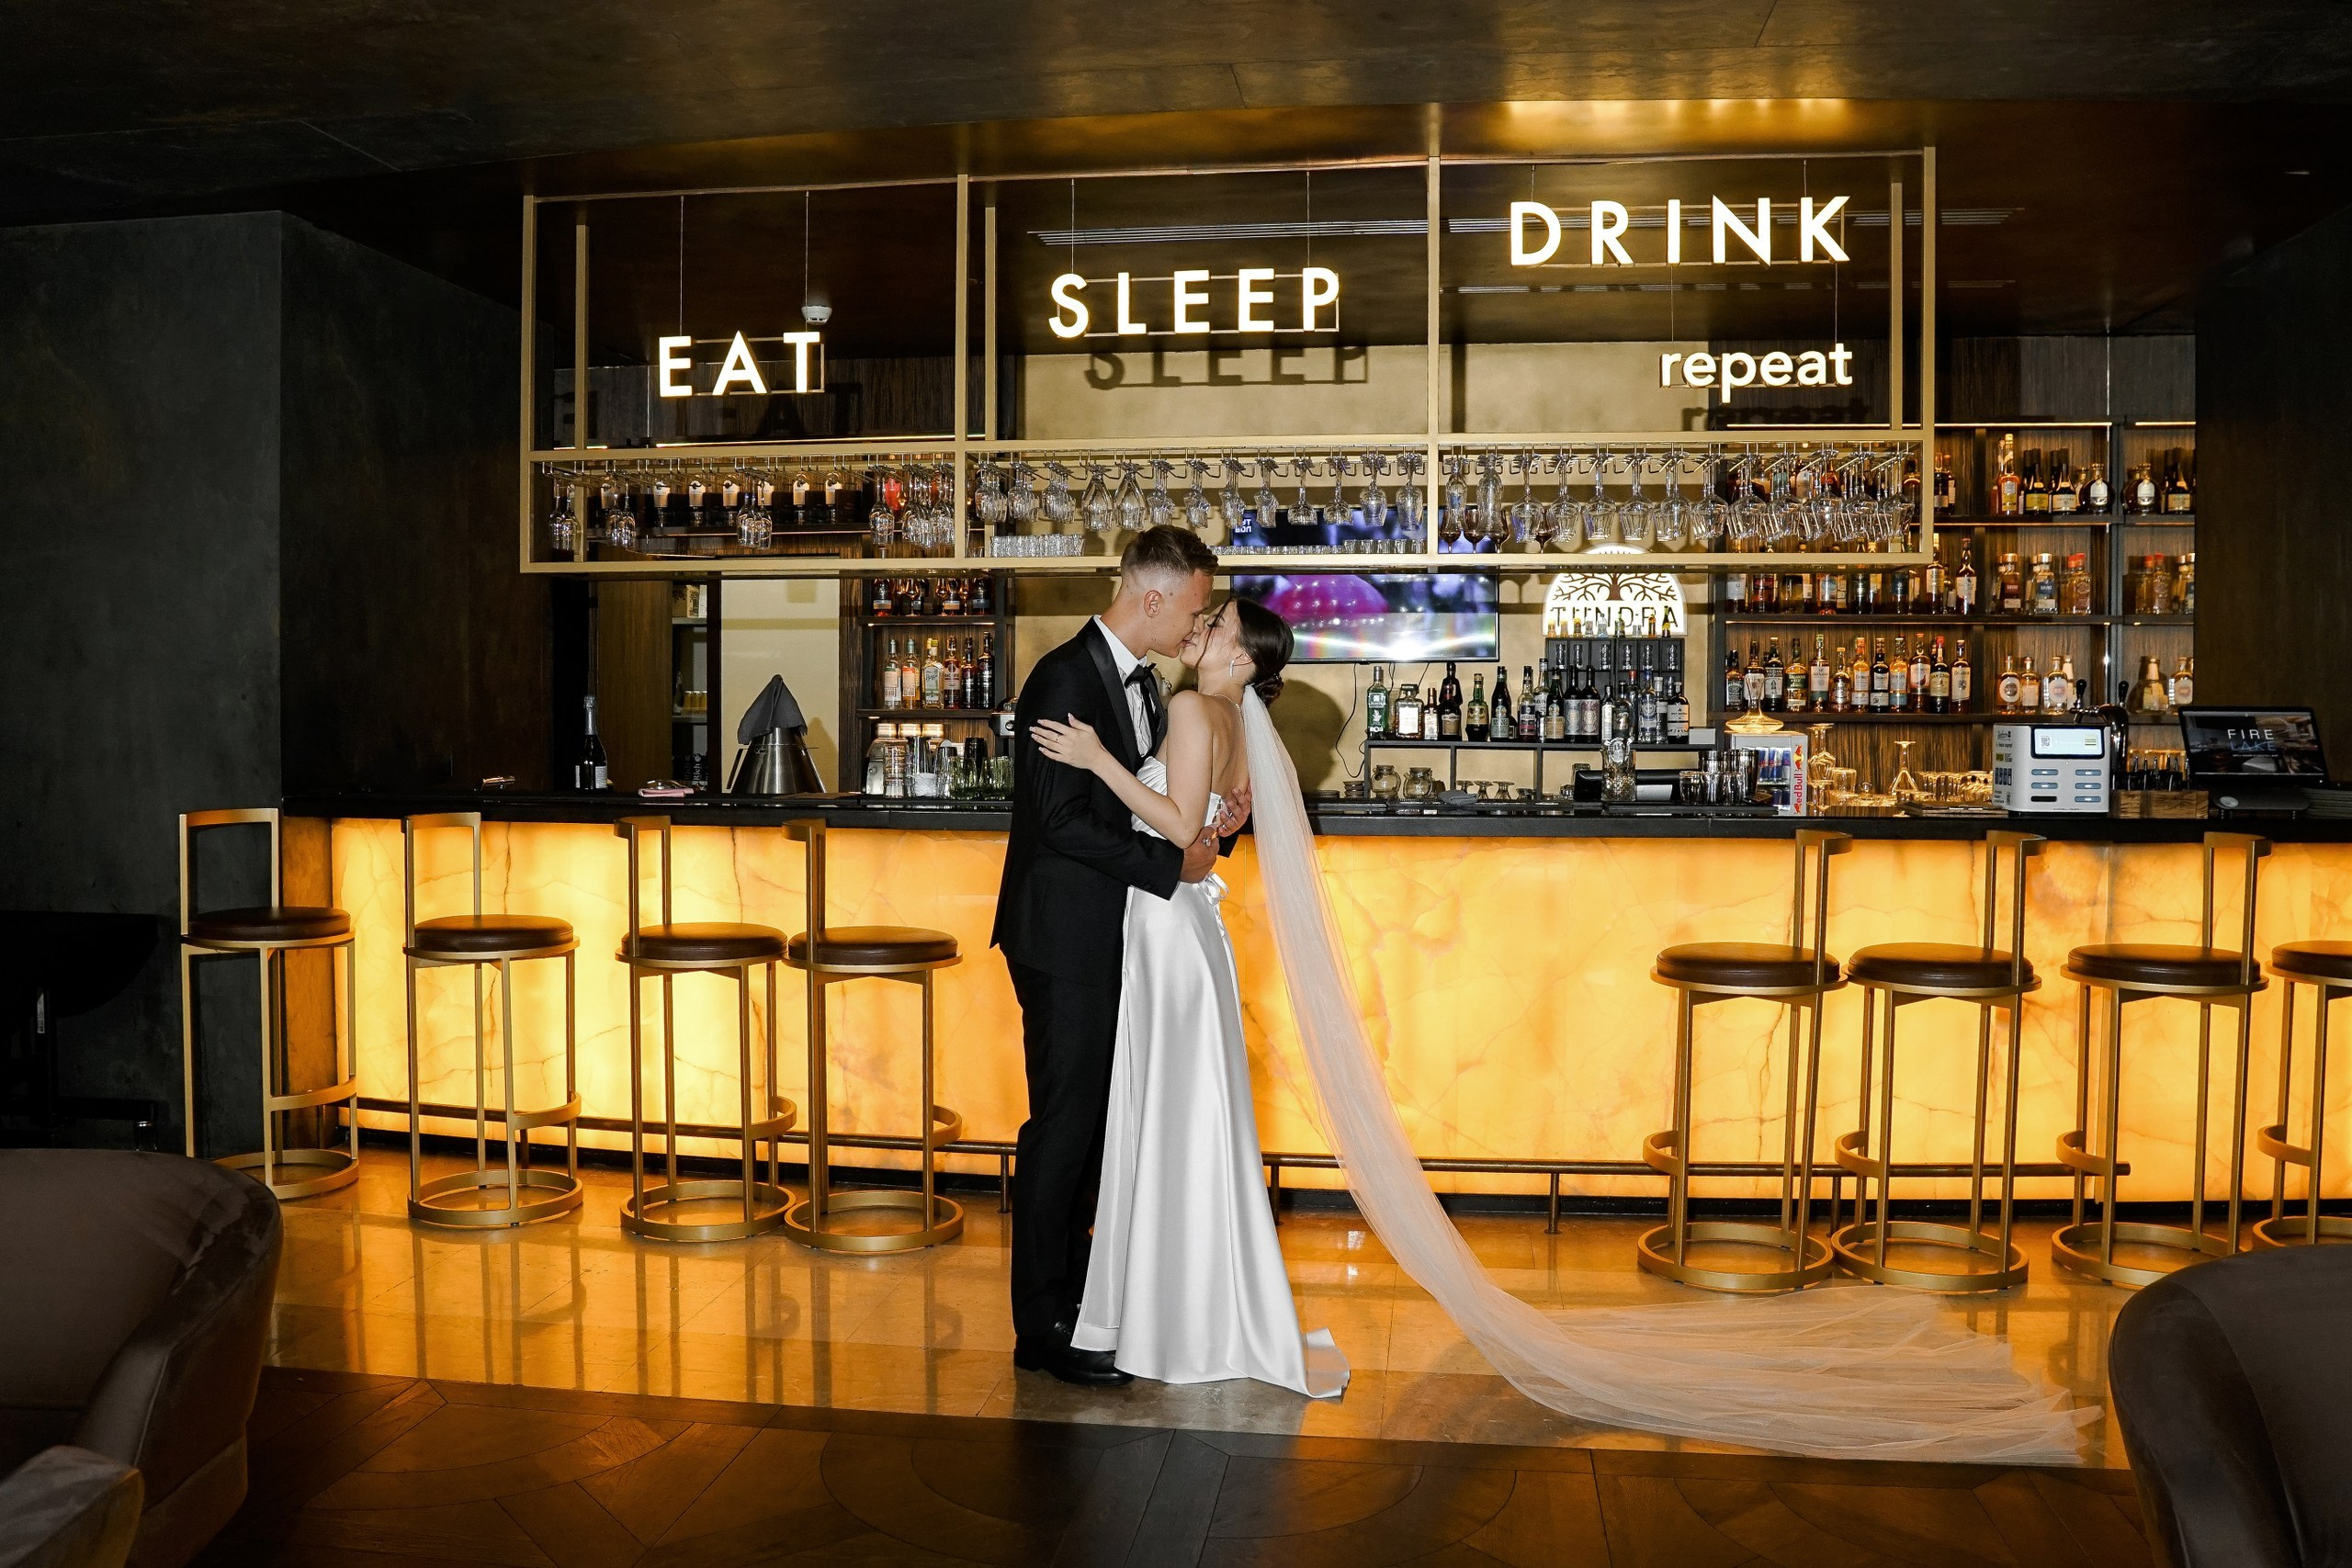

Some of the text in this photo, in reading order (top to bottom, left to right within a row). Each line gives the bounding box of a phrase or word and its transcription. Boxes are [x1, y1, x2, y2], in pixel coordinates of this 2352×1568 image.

[1510, 195, 1849, 266] DRINK
[1048, 267, 1340, 338] SLEEP
[659, 331, 820, 397] EAT
[1662, 343, 1852, 403] repeat
[2227, 728, 2274, 739] FIRE
[2229, 740, 2277, 751] LAKE
[693, 763, 701, 781] Rich
[1793, 773, 1803, 790] Bull
